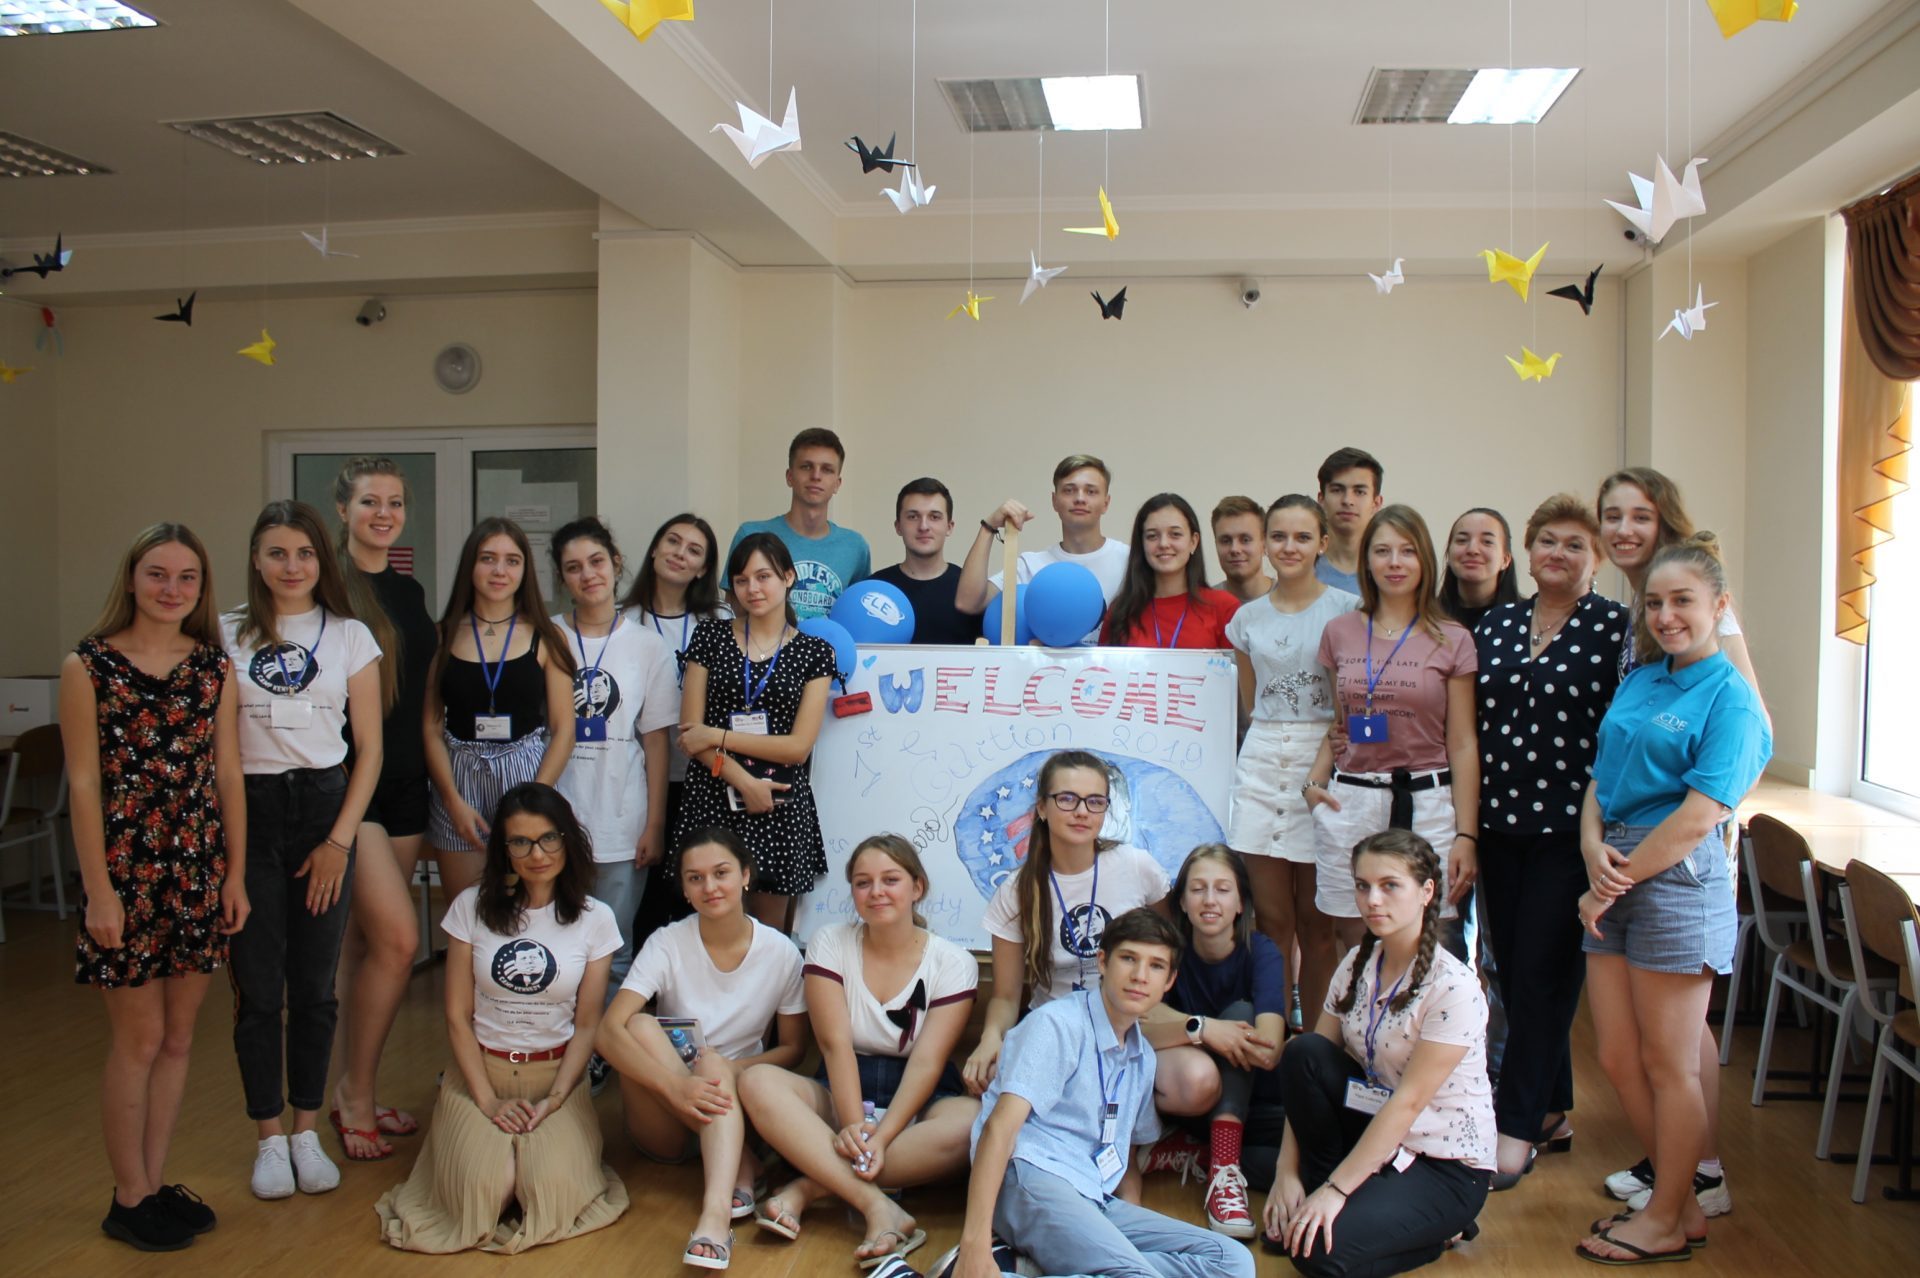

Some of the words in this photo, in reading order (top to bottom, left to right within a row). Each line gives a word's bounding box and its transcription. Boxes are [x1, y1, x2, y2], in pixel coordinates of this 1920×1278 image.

[791, 591, 833, 605] ONGBOARD
[1345, 657, 1372, 665] SORR
[1397, 659, 1419, 668] LATE
[1354, 678, 1383, 686] MISD
[1385, 679, 1397, 687] MY
[1400, 680, 1417, 688] BUS
[878, 666, 1206, 732] WELCOME
[1353, 692, 1395, 700] OVESLEPT
[1112, 724, 1203, 772] 2019
[513, 984, 541, 992] KENNEDY
